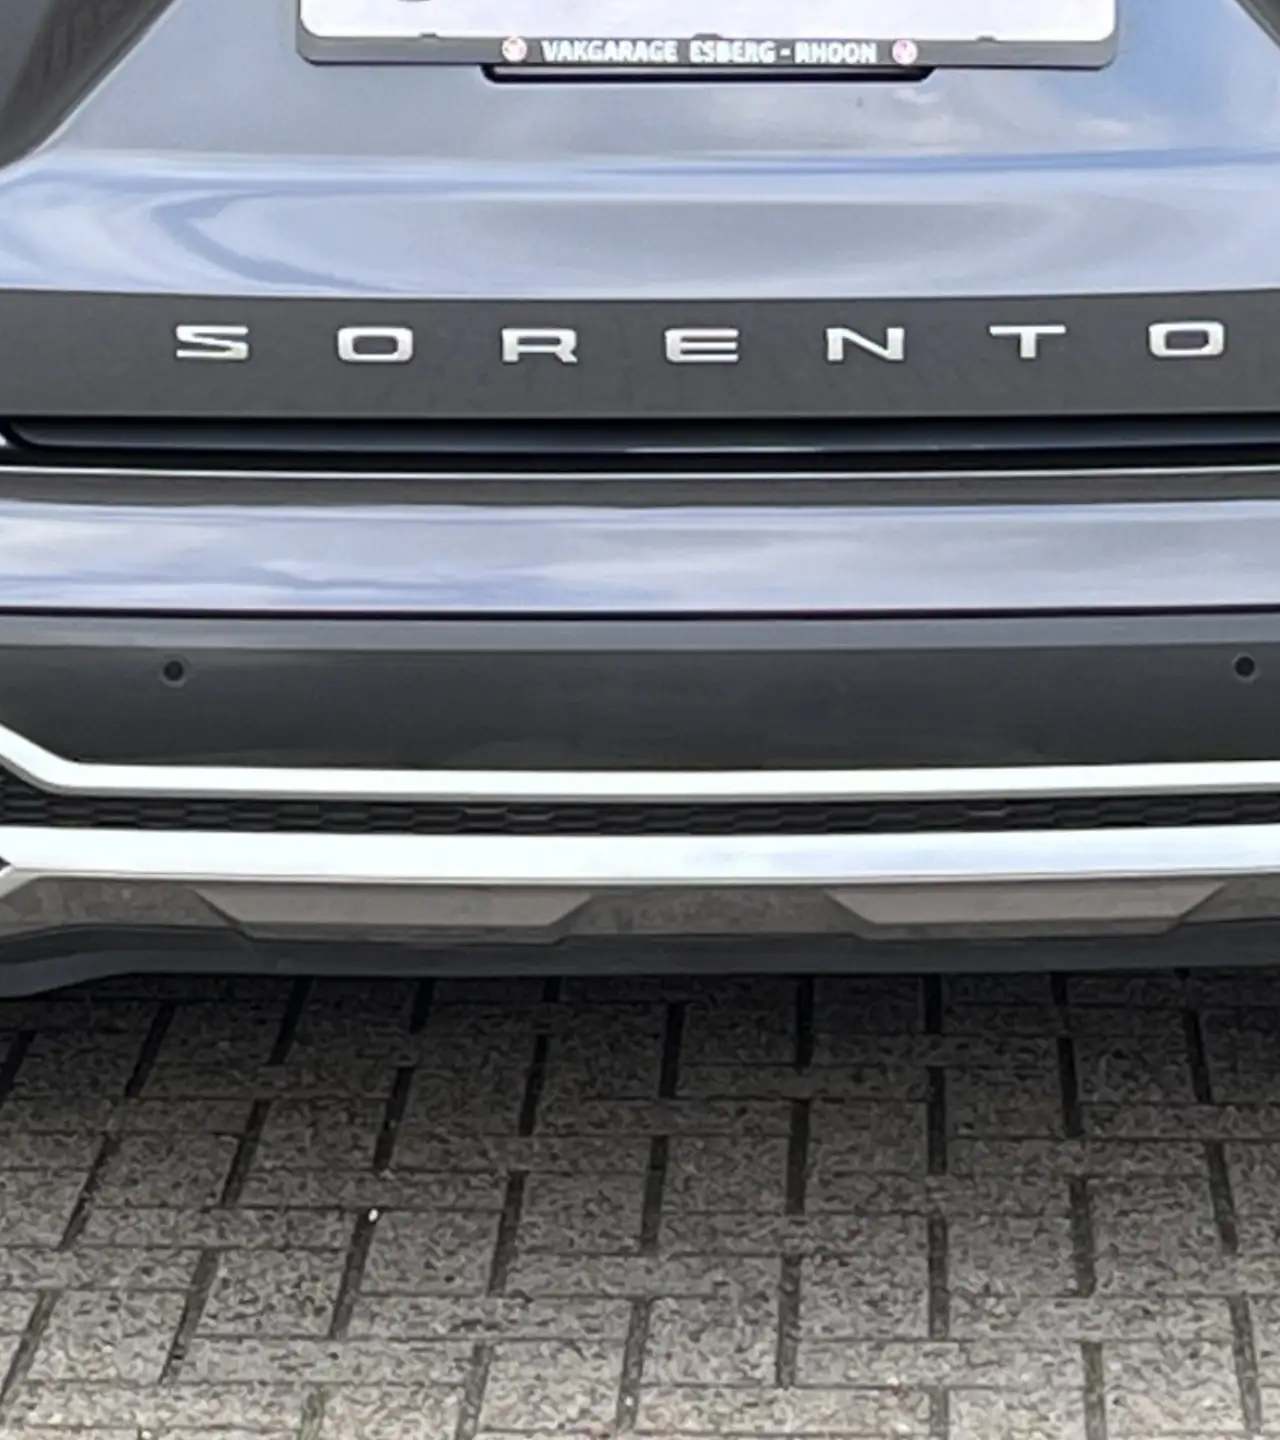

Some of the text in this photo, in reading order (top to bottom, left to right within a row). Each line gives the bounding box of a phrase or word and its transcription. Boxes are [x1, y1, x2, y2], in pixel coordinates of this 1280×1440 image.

[540, 40, 679, 63] VAKGARAGE
[689, 40, 776, 63] ESBERG
[175, 321, 1226, 364] SORENTO
